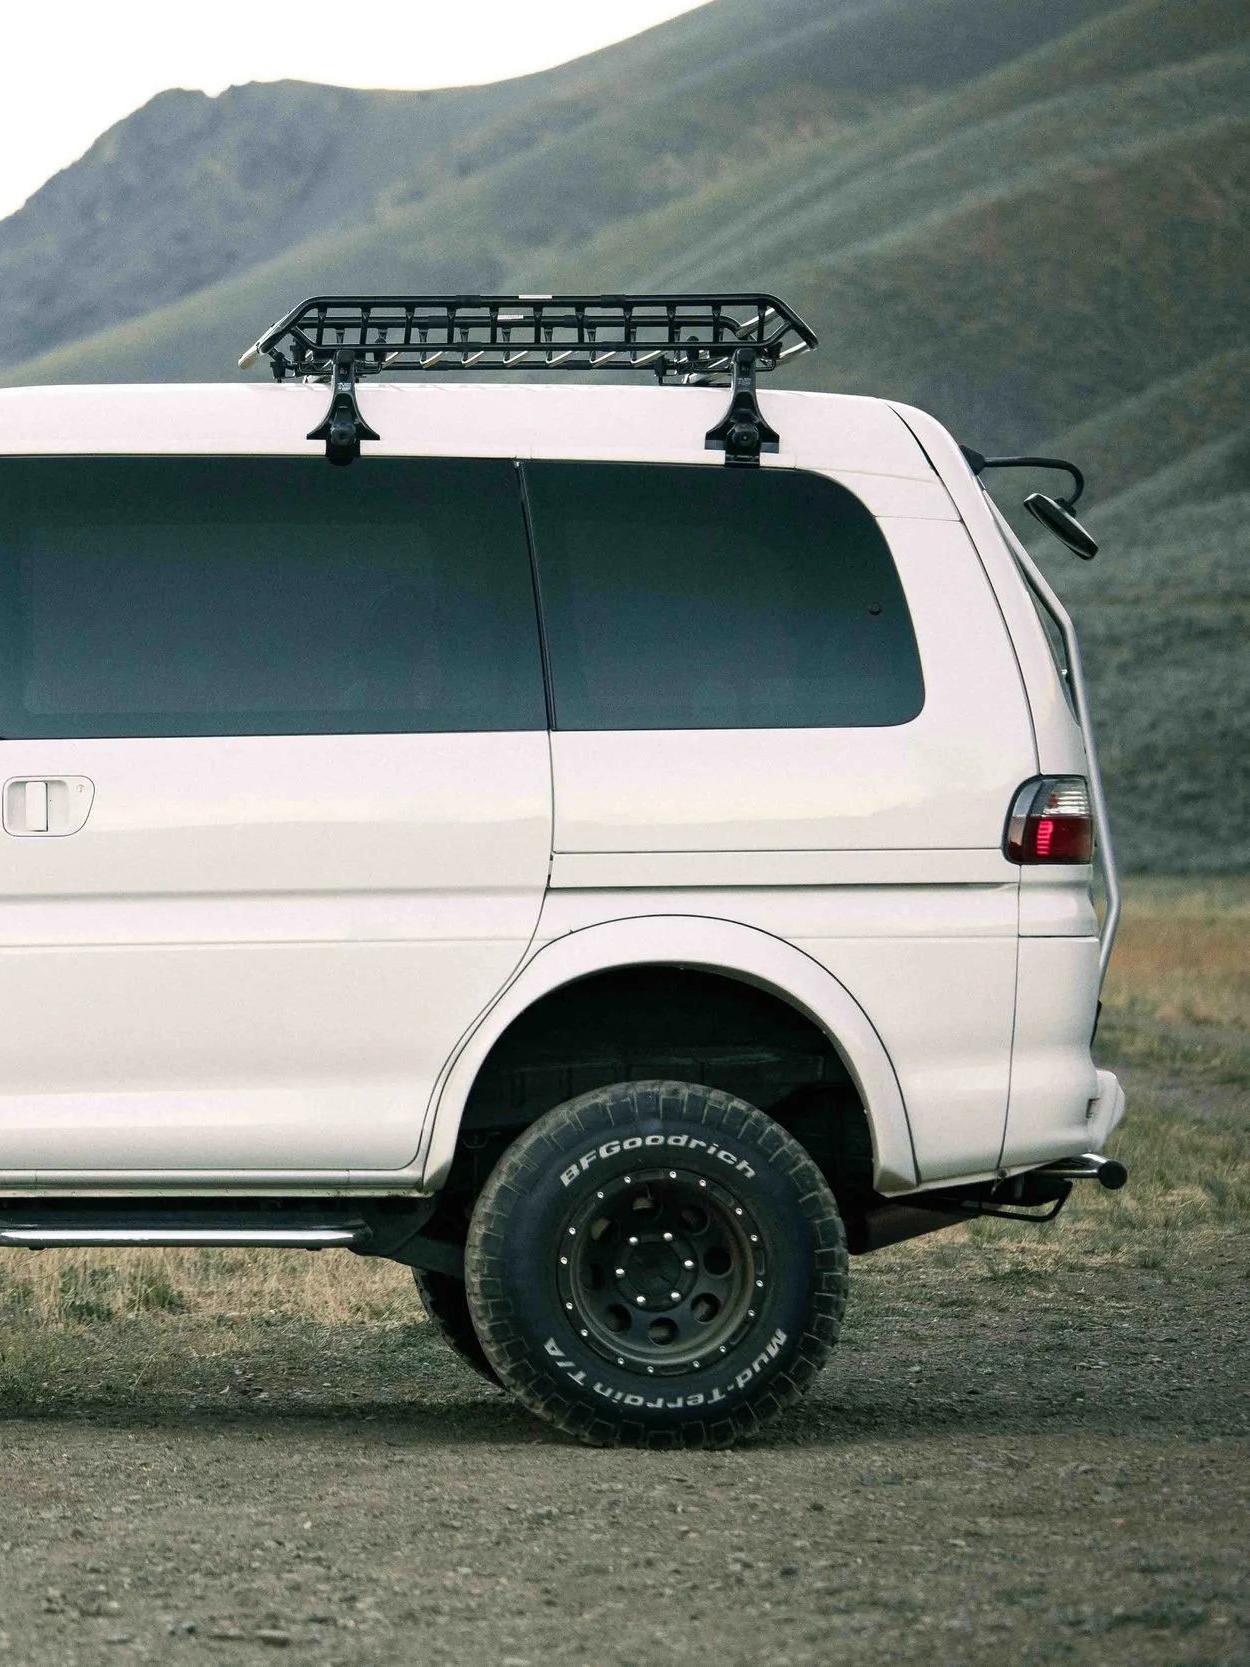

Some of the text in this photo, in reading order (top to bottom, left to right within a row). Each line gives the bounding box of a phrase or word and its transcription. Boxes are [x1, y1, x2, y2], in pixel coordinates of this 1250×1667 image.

[559, 1134, 756, 1188] BFGoodrich
[543, 1328, 788, 1409] Mud-Terrain T/A
